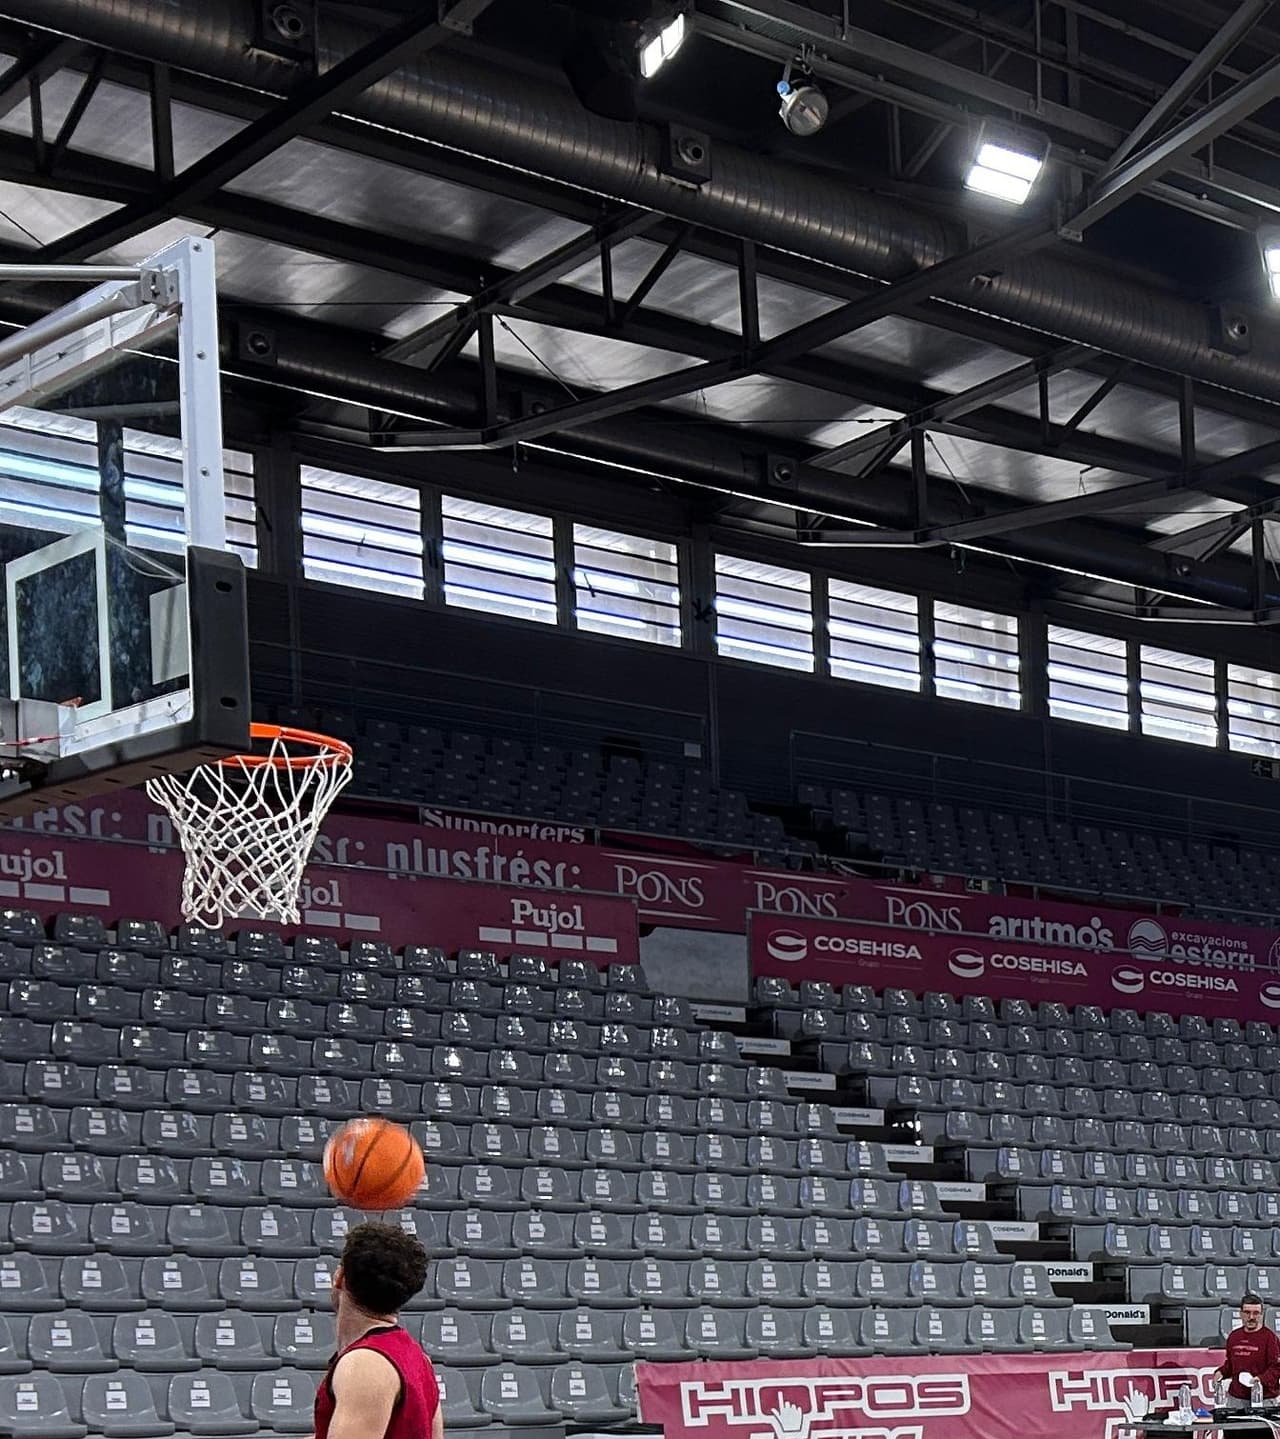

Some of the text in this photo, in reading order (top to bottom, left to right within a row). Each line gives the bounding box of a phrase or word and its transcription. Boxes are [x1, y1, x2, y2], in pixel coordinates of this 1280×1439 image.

[0, 850, 67, 879] ujol
[614, 864, 704, 908] PONS
[754, 881, 839, 918] PONS
[510, 898, 585, 933] Pujol
[885, 896, 963, 933] PONS
[813, 935, 922, 961] COSEHISA
[1171, 931, 1248, 950] excavacions
[990, 953, 1088, 977] COSEHISA
[1150, 970, 1239, 992] COSEHISA
[1047, 1267, 1089, 1277] Donald's
[1104, 1310, 1145, 1319] Donald's
[681, 1373, 971, 1427] HIOPOS
